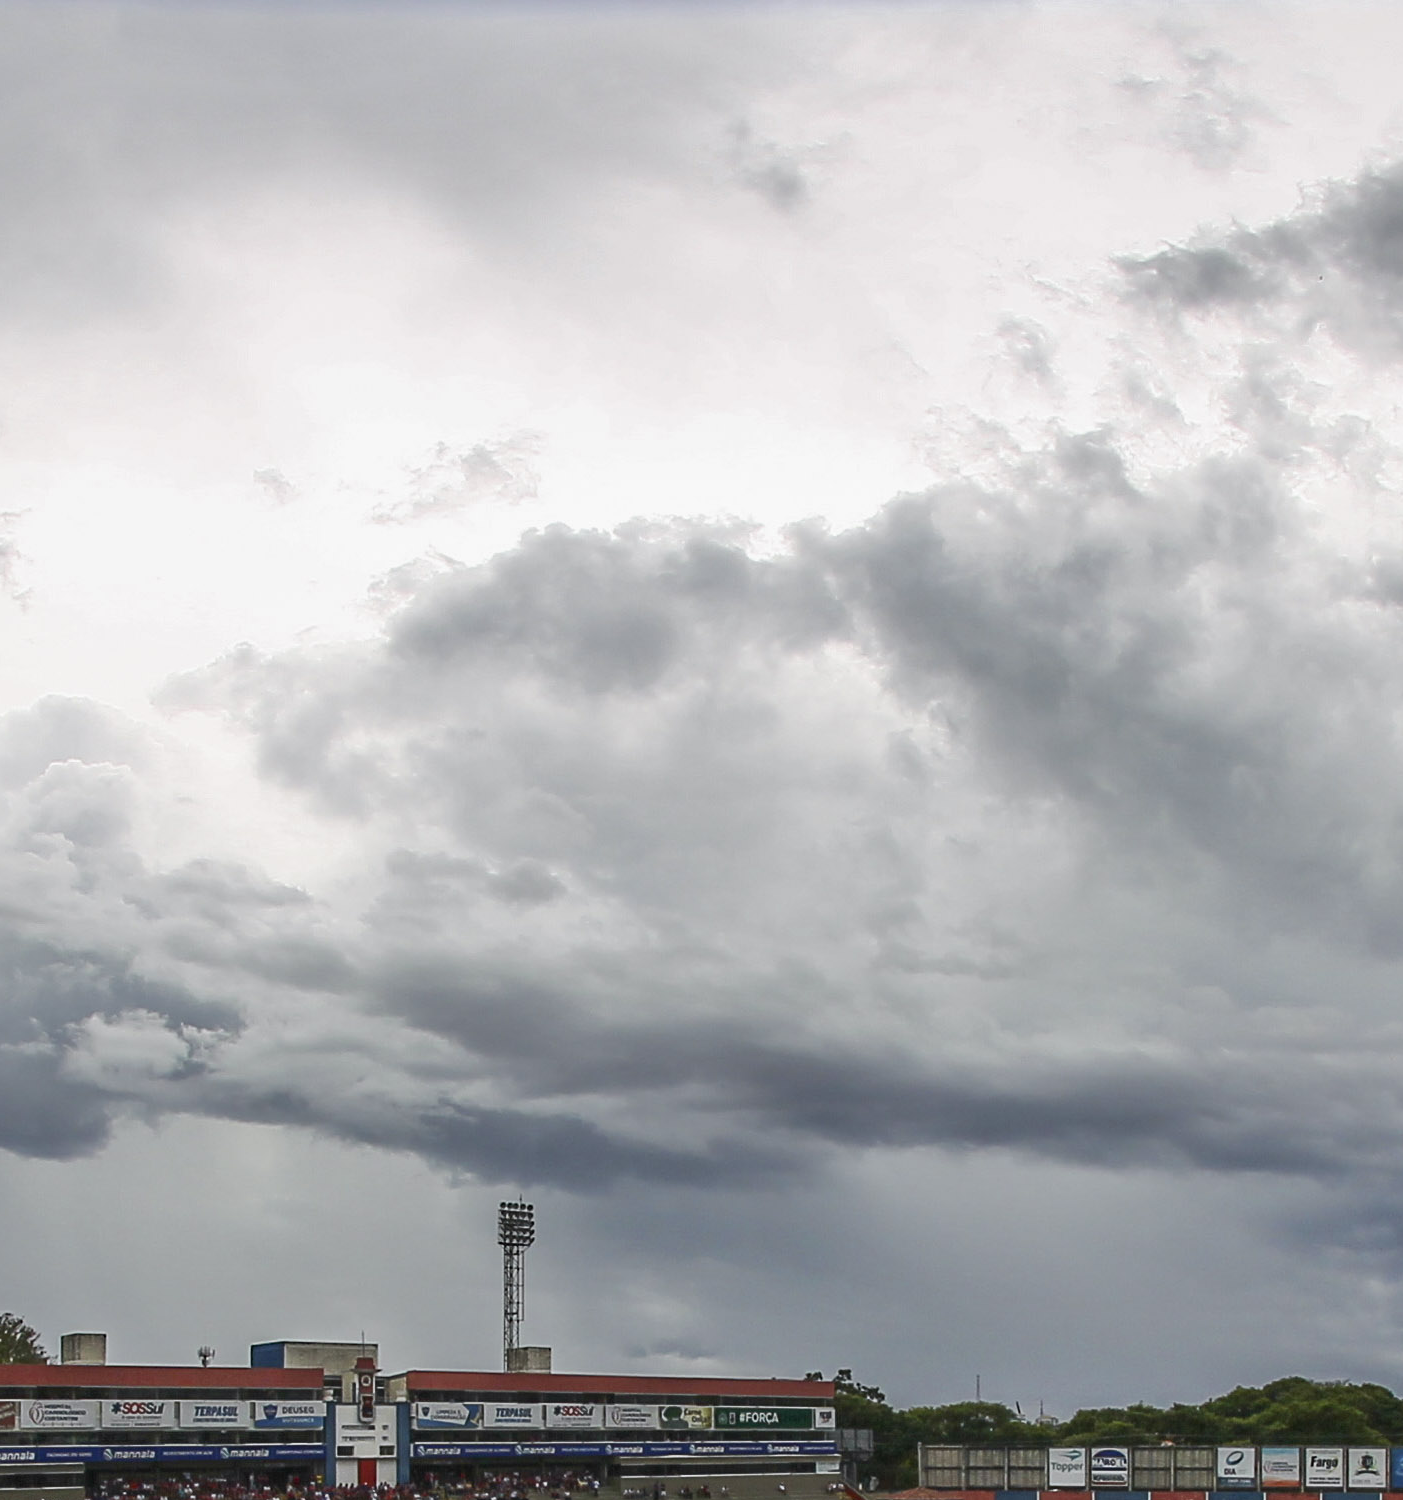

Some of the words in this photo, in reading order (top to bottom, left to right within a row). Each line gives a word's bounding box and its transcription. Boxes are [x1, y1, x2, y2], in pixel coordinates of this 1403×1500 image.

[194, 1405, 238, 1416] TERPASUL
[282, 1406, 314, 1414] DEUSEG
[495, 1407, 532, 1417] TERPASUL
[1051, 1462, 1084, 1473] Topper
[1310, 1455, 1339, 1470] Fargo
